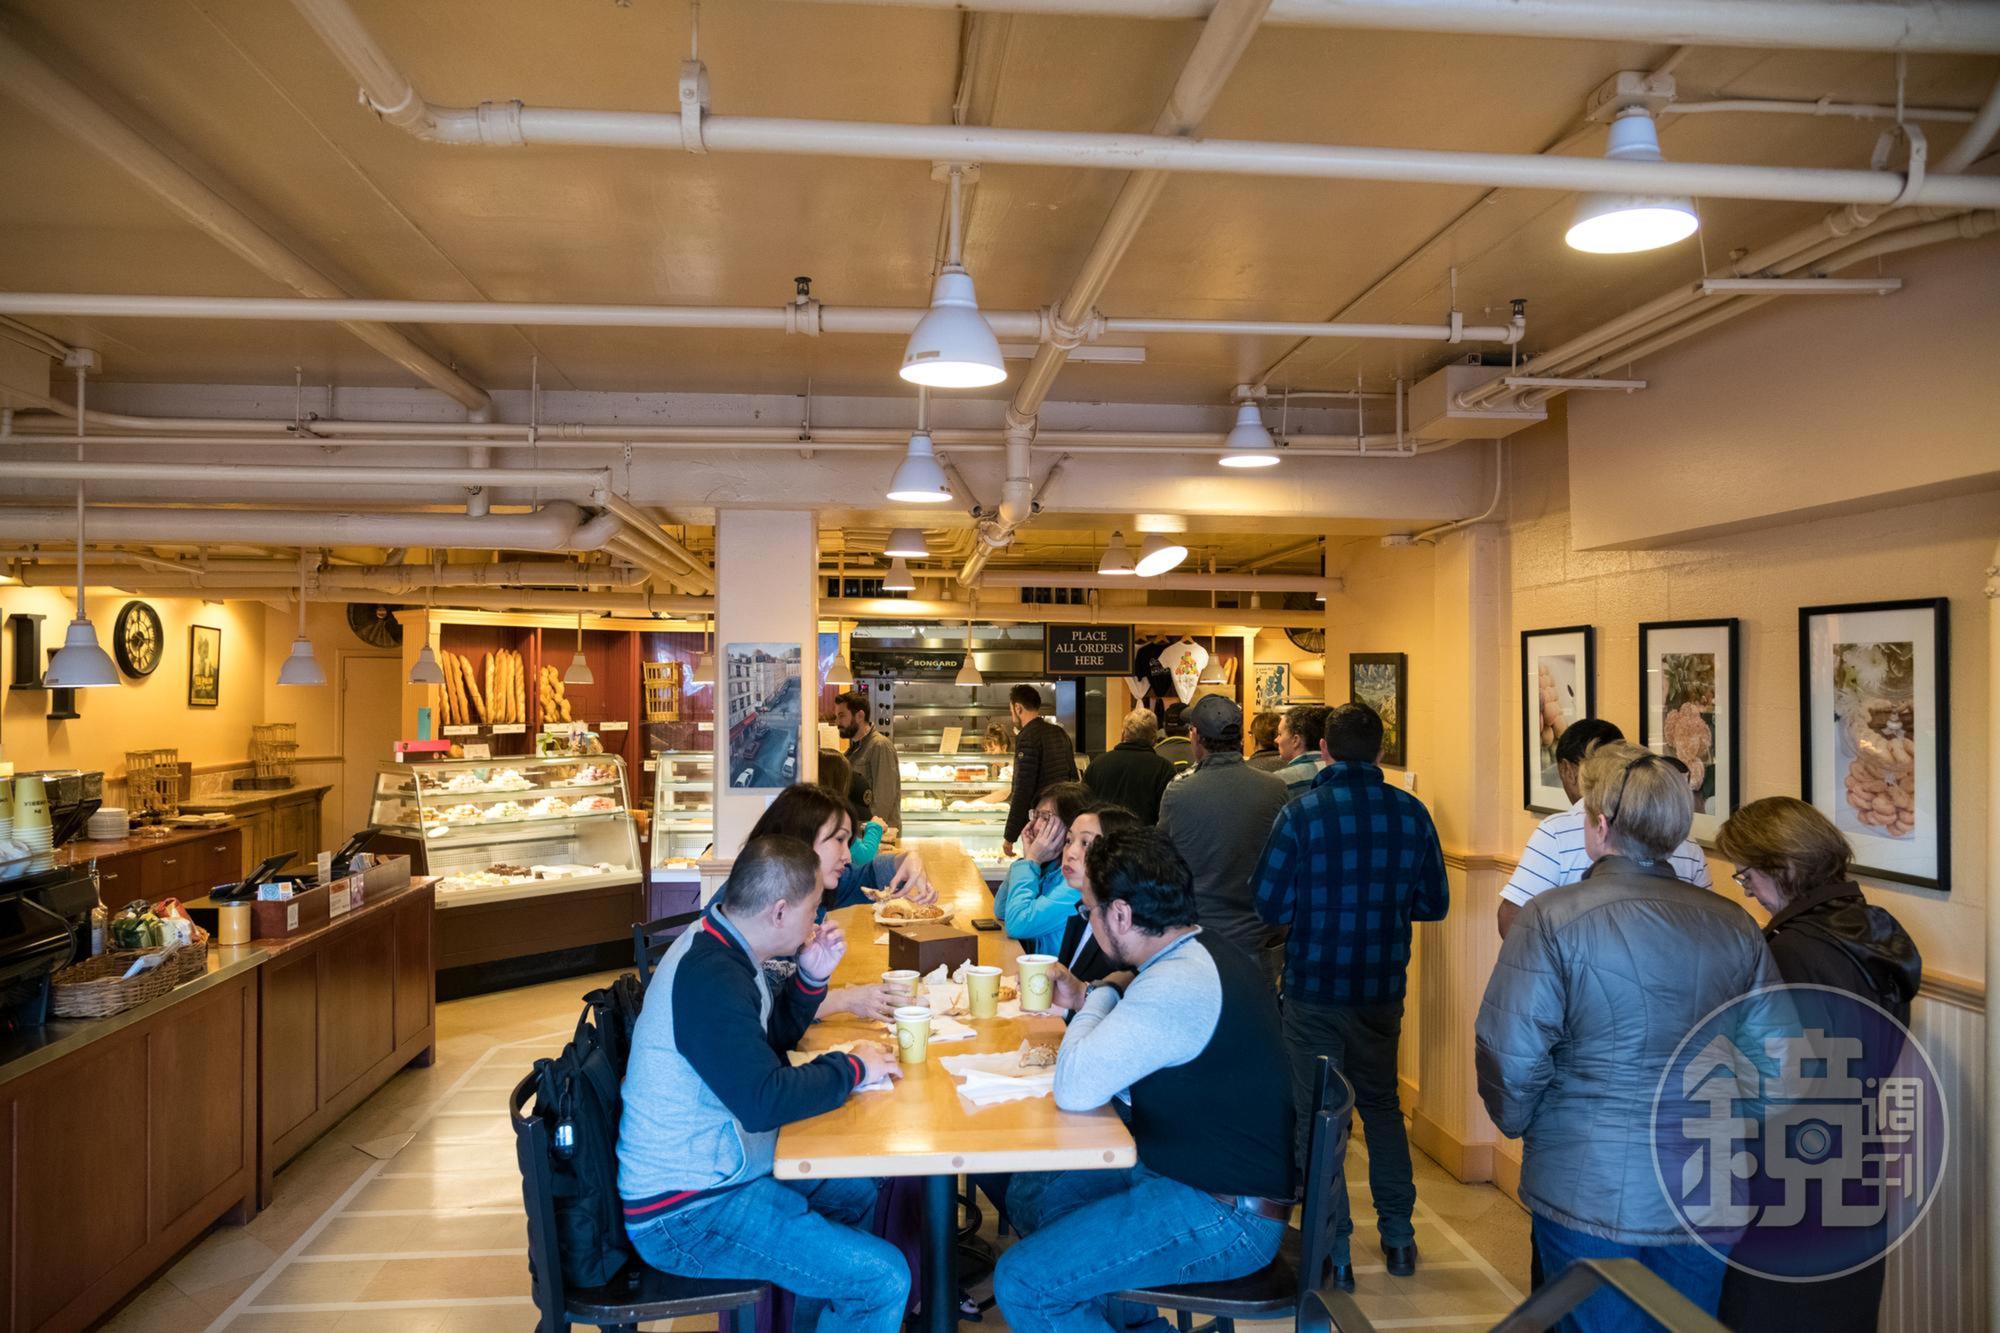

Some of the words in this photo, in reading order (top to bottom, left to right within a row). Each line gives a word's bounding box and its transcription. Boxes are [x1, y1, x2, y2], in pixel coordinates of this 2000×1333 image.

[1072, 631, 1107, 640] PLACE
[1055, 643, 1076, 653] ALL
[1079, 643, 1124, 653] ORDERS
[1075, 655, 1104, 665] HERE
